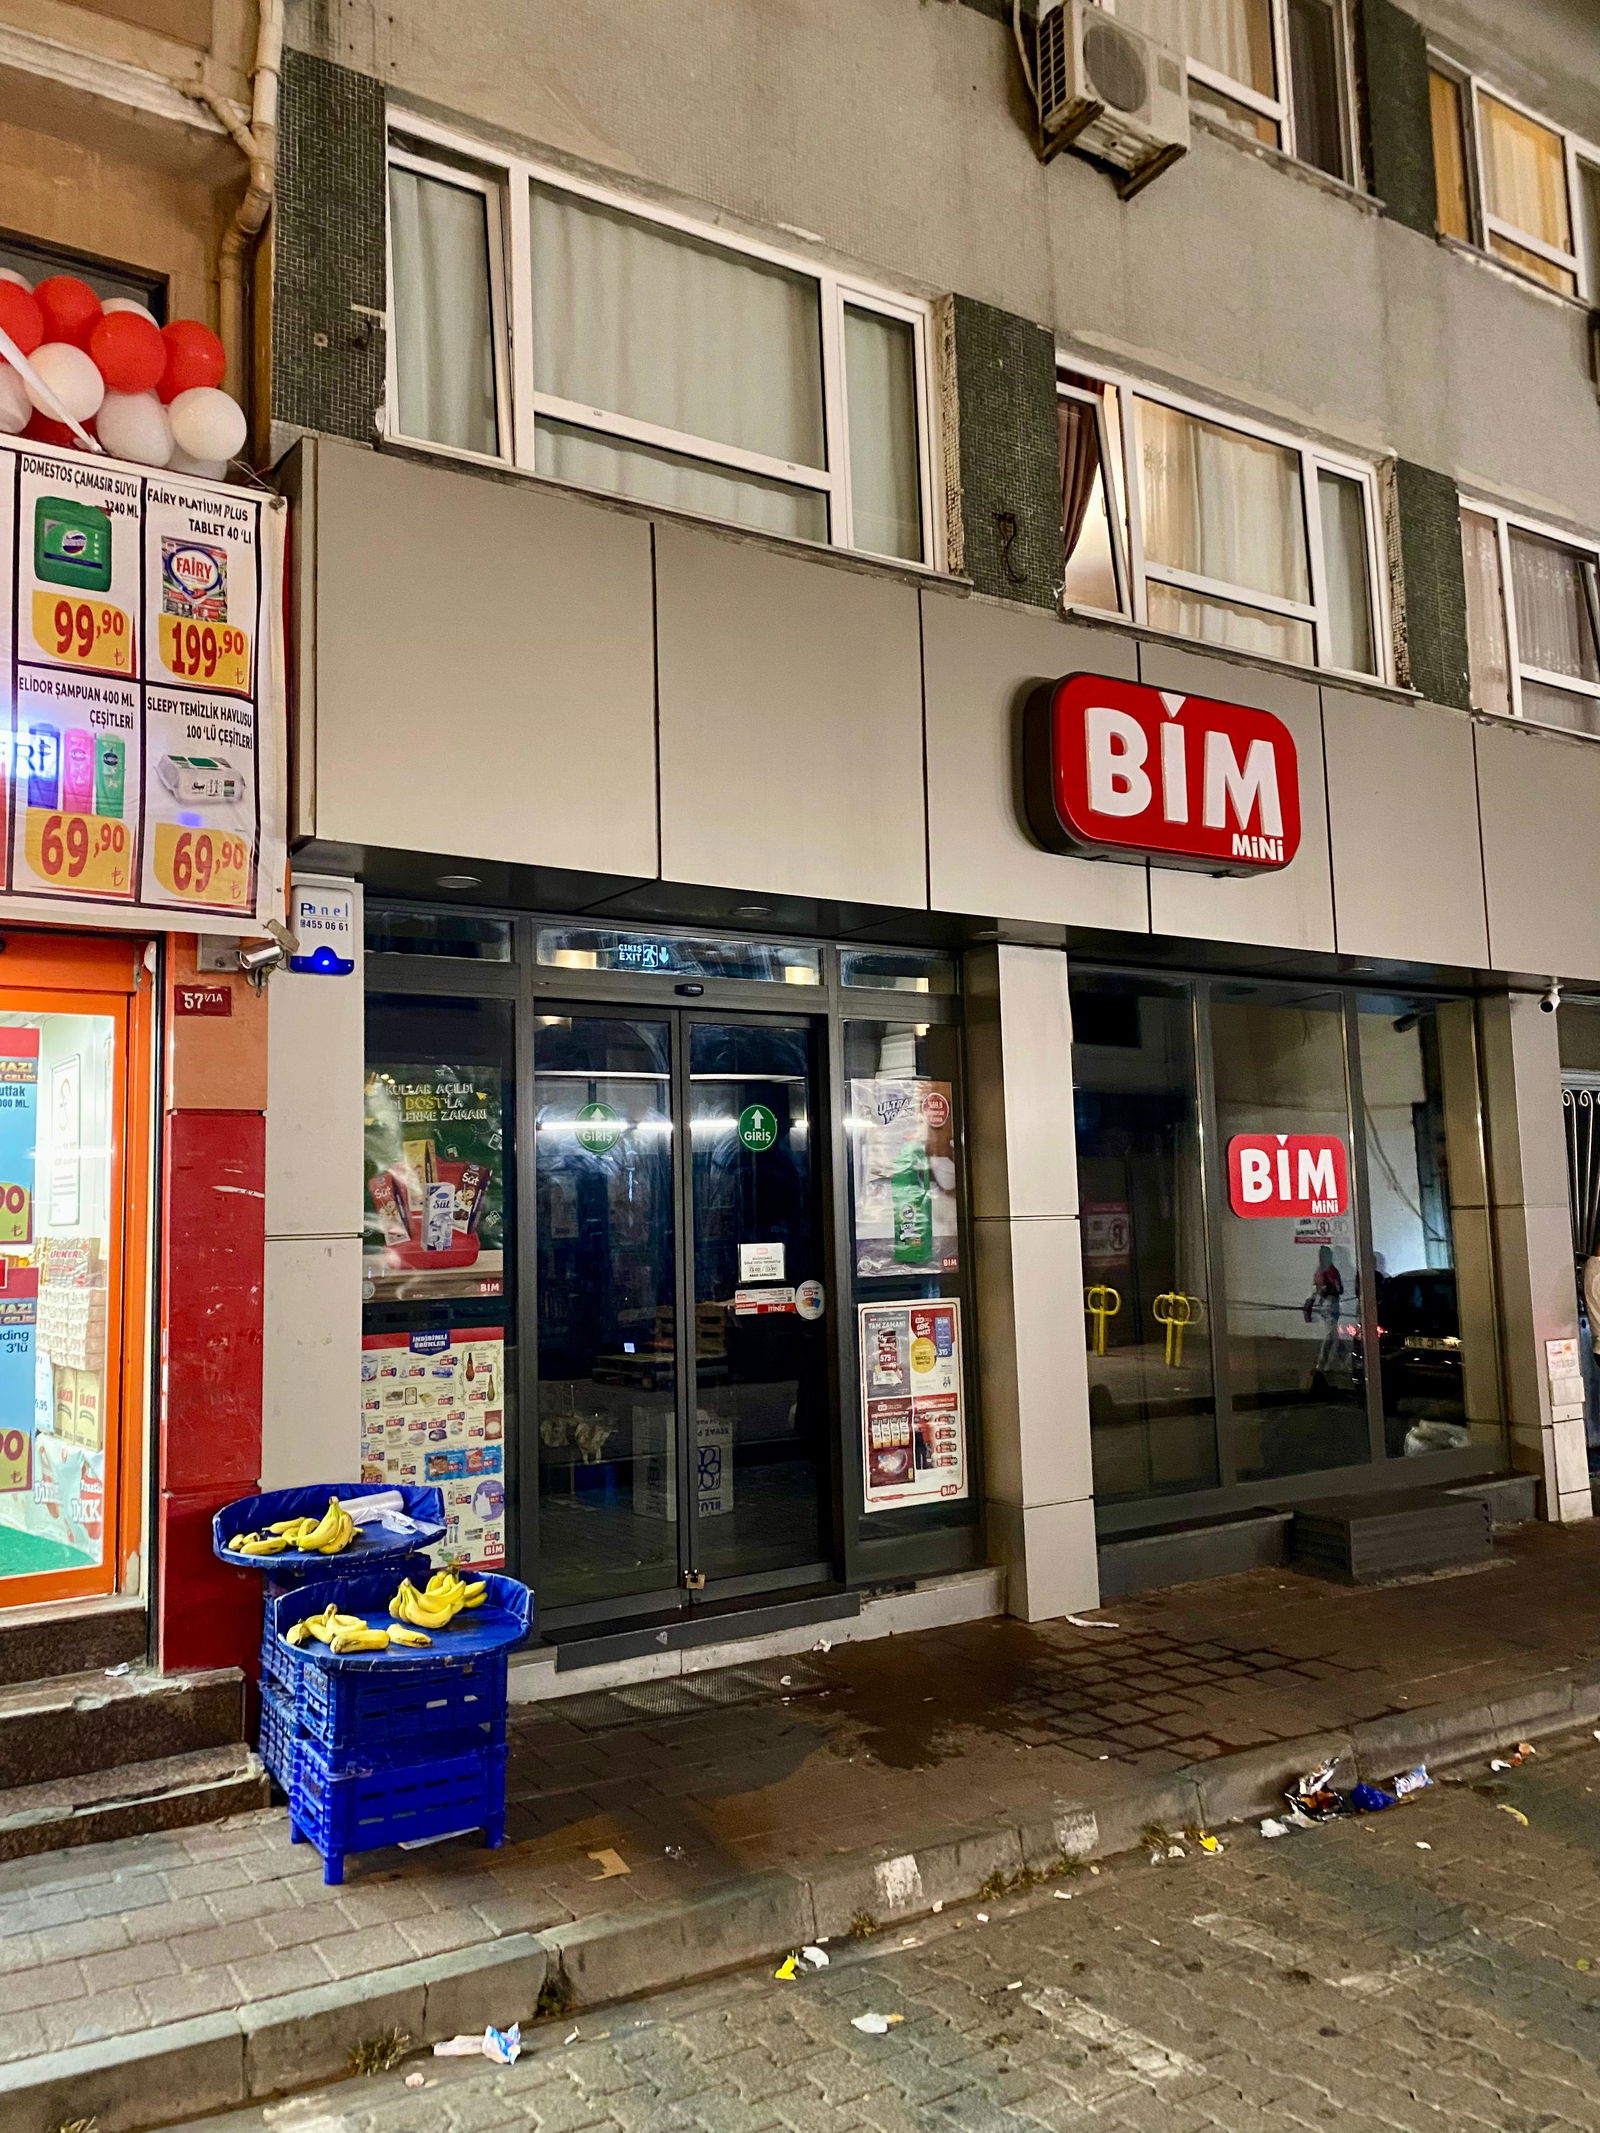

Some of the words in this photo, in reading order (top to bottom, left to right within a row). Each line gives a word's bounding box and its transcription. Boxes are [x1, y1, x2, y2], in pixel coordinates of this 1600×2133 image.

[22, 457, 73, 483] DOMESTOS
[114, 480, 138, 499] SUYU
[127, 505, 139, 519] ML
[147, 488, 177, 509] FAİRY
[178, 493, 223, 516] PLATİUM
[224, 504, 249, 522] PLUS
[188, 518, 226, 538] TABLET
[227, 526, 239, 540] 40
[176, 557, 213, 579] FAİRY
[54, 600, 124, 658] 99,90
[172, 621, 244, 678] 199,90
[19, 675, 54, 694] ELİDOR
[55, 682, 101, 703] ŞAMPUAN
[103, 690, 120, 706] 400
[121, 693, 135, 708] ML
[89, 708, 134, 730] ÇEŞİTLERİ
[147, 696, 180, 715] SLEEPY
[180, 699, 219, 720] TEMİZLİK
[220, 706, 253, 728] HAVLUSU
[186, 724, 202, 740] 100
[218, 729, 254, 750] ÇEŞİTLERİ
[1084, 692, 1285, 837] BİM
[41, 815, 125, 878] 69,90
[173, 832, 244, 893] 69,90
[300, 902, 350, 918] Panel
[306, 919, 323, 930] 455
[325, 920, 337, 931] 06
[338, 922, 350, 932] 61
[619, 951, 643, 963] EXIT
[183, 992, 204, 1010] 57
[582, 1129, 613, 1144] GİRİŞ
[743, 1128, 772, 1143] GİRİŞ
[1239, 1134, 1338, 1203] BİM
